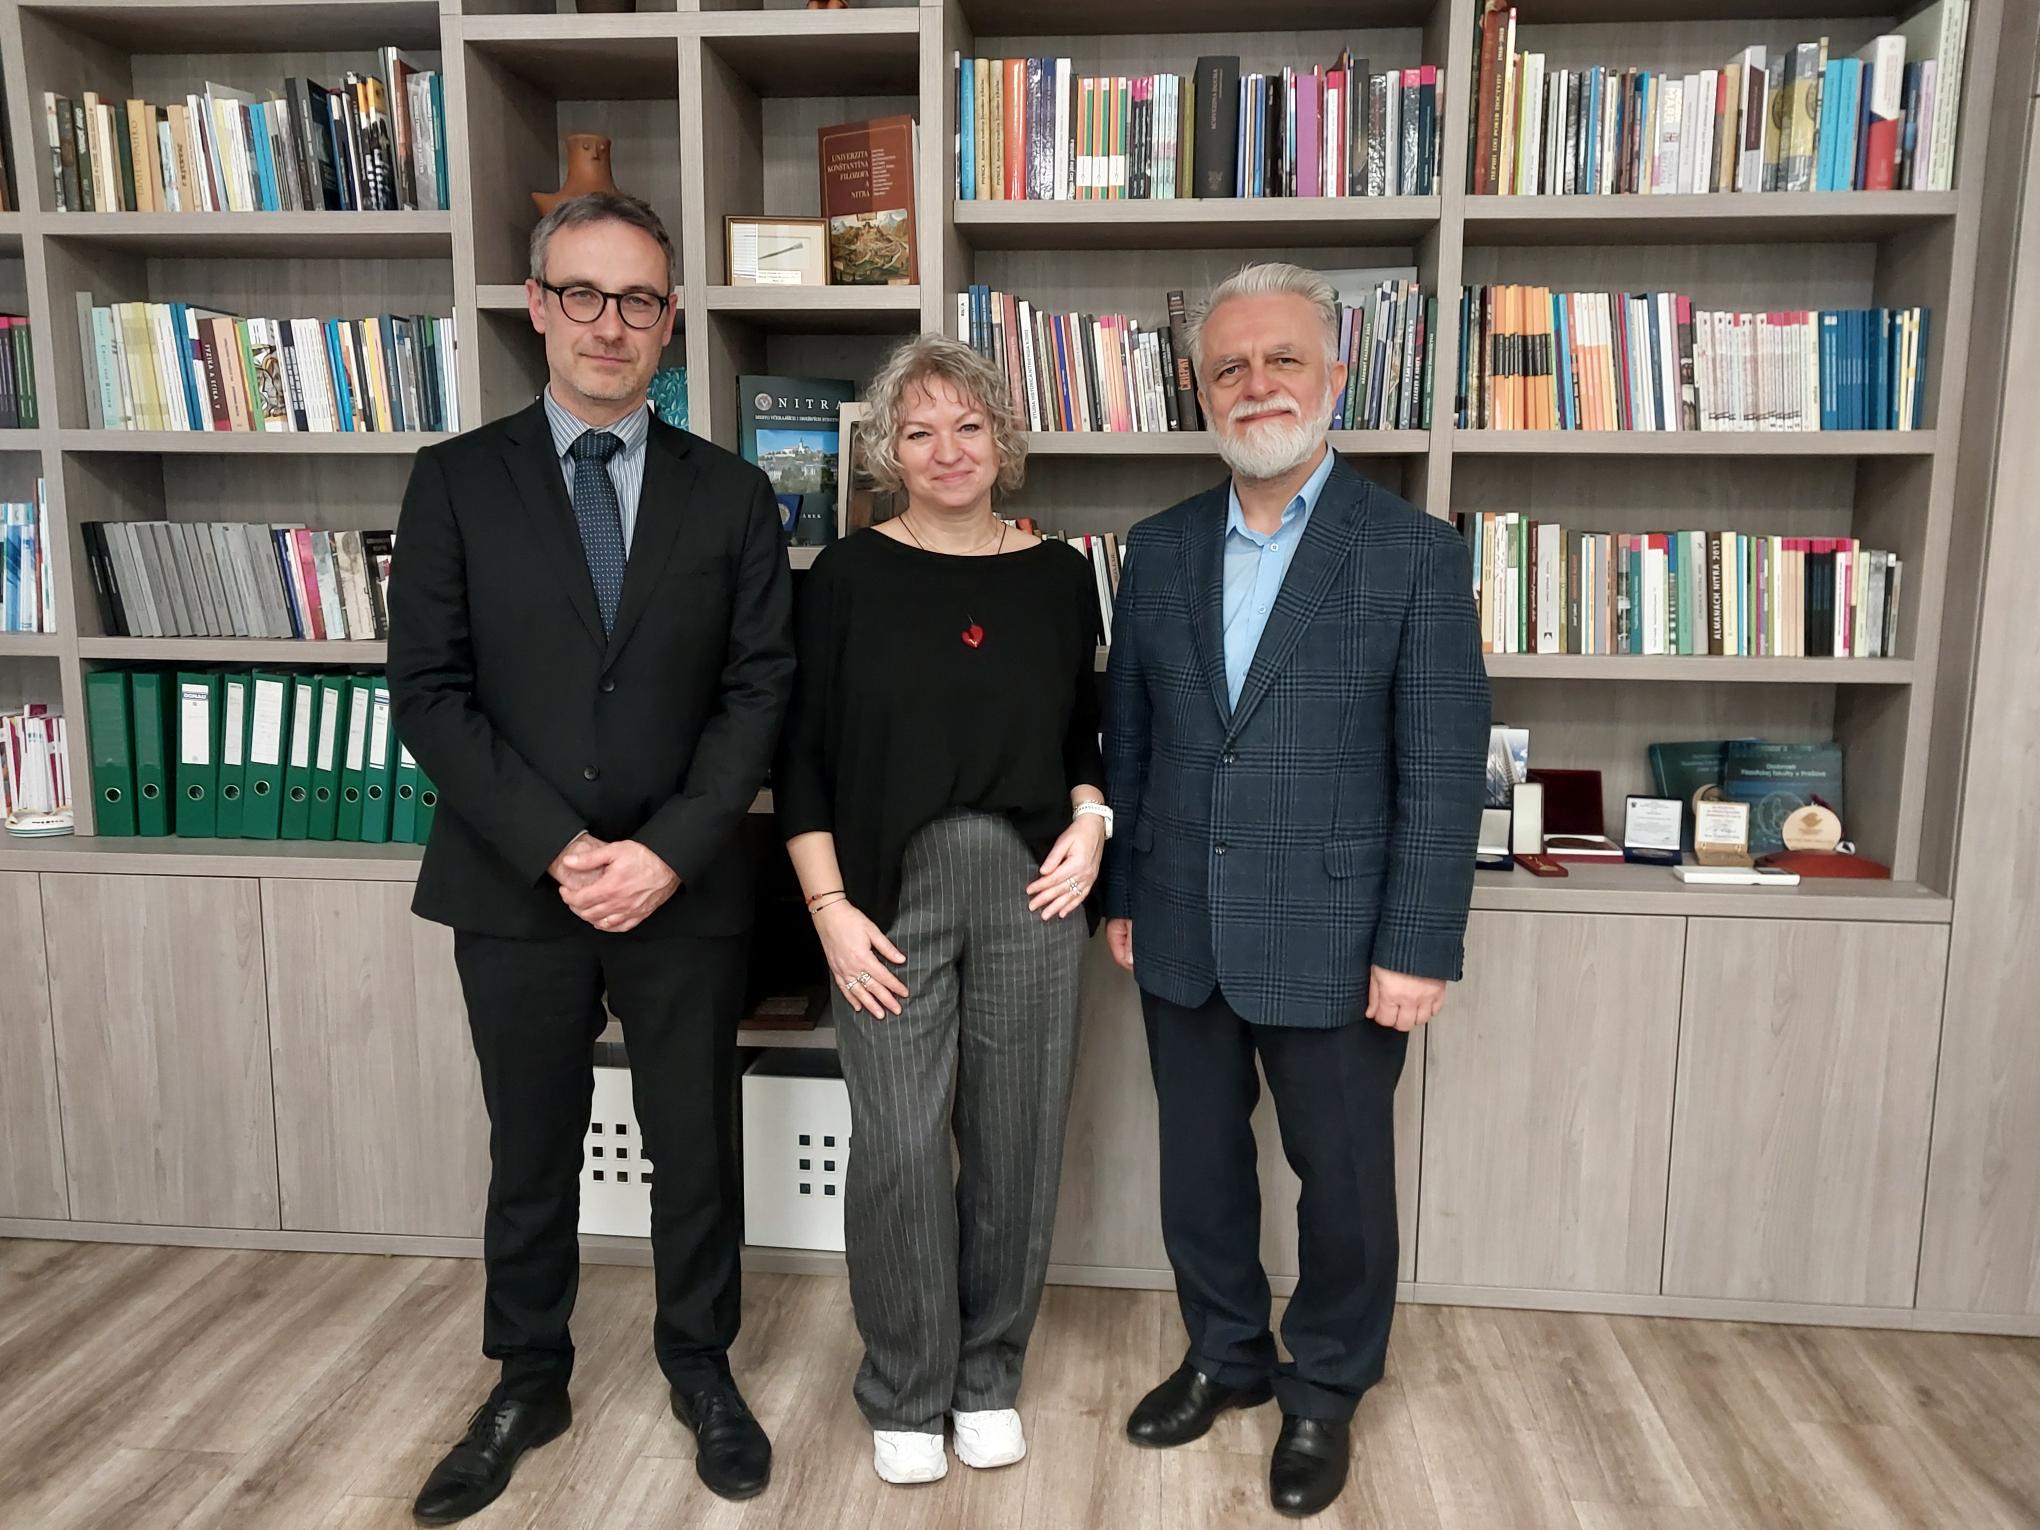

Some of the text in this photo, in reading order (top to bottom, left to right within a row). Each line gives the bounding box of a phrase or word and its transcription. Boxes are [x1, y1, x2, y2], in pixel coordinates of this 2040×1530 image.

[1664, 88, 1675, 125] MARR
[832, 150, 869, 162] UNIVERZITA
[840, 170, 869, 181] FILOZOFA
[850, 190, 870, 198] NITRA
[204, 344, 214, 370] FYZIKA
[210, 380, 219, 400] ETIKA
[1025, 346, 1033, 373] NITRIENSIA
[1712, 540, 1721, 640] ALMANACH NITRA 2013
